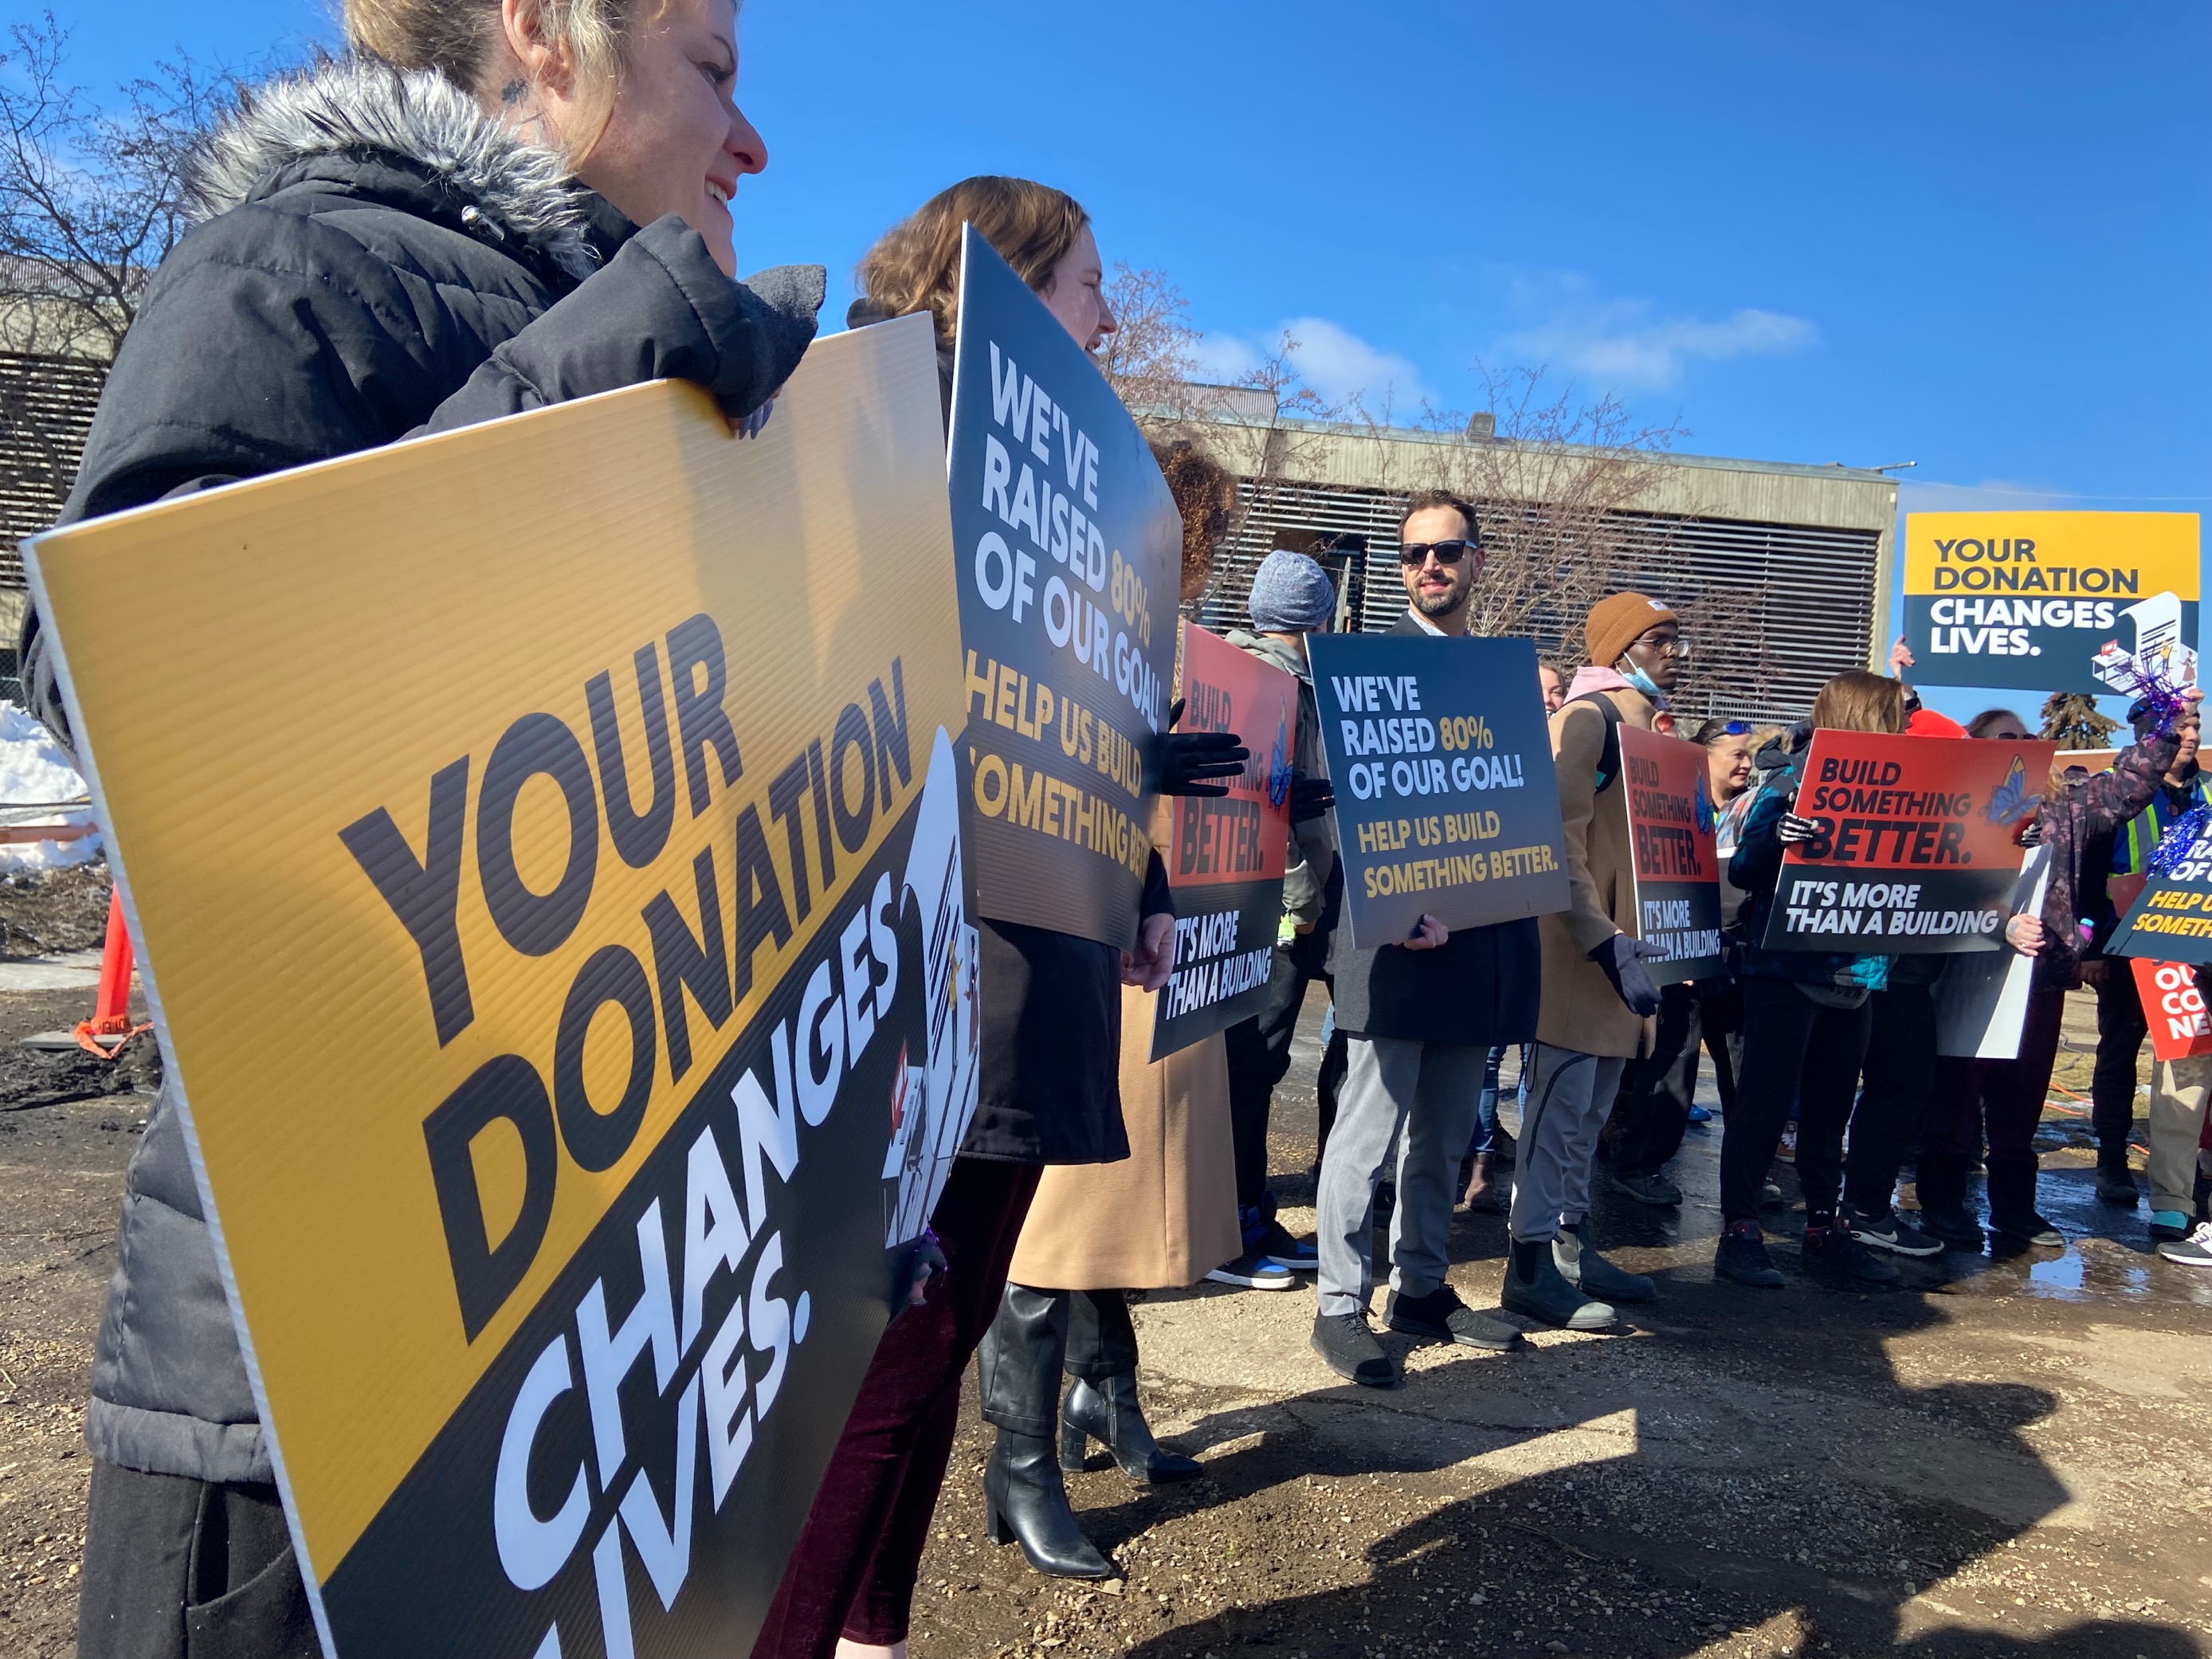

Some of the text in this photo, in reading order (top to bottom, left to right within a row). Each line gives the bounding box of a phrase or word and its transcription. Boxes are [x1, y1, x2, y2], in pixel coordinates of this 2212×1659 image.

[989, 340, 1100, 512] WE'VE
[982, 433, 1151, 649] RAISED 80%
[1933, 539, 2037, 563] YOUR
[1933, 566, 2139, 594] DONATION
[975, 531, 1037, 624] OF
[1043, 575, 1109, 682] OUR
[1930, 598, 2115, 629] CHANGES
[1930, 626, 2041, 657] LIVES.
[1190, 679, 1232, 734] BUILD
[1331, 676, 1422, 712] WE'VE
[965, 649, 1054, 742] HELP
[1061, 696, 1092, 765] US
[1097, 718, 1142, 798] BUILD
[1340, 716, 1494, 756] RAISED 80%
[1348, 754, 1524, 801] OF OUR GOAL!
[1629, 756, 1660, 788] BUILD
[1819, 757, 1902, 786] BUILD
[970, 747, 1128, 865] OMETHING
[1633, 789, 1691, 824] SOMETHING
[1812, 786, 1971, 818] SOMETHING
[338, 613, 743, 1049] YOUR
[1179, 795, 1264, 875] BETTER.
[1357, 810, 1501, 853] HELP US BUILD
[1637, 824, 1702, 877] BETTER.
[1801, 815, 1972, 865] BETTER.
[1363, 845, 1559, 899] SOMETHING BETTER.
[1789, 880, 1921, 908] IT'S MORE
[1643, 900, 1691, 931] IT'S MORE
[1786, 908, 1999, 935] THAN A BUILDING
[2147, 890, 2203, 910] HELP
[1198, 910, 1240, 960] MORE
[1675, 931, 1684, 960] A
[1683, 928, 1721, 959] BUILDING
[2132, 912, 2212, 939] SOMETH
[422, 656, 912, 1346] DONATION
[1166, 946, 1273, 1021] THAN A BUILDING
[494, 871, 899, 1590] CHANGES
[533, 1230, 810, 1659] IVES.
